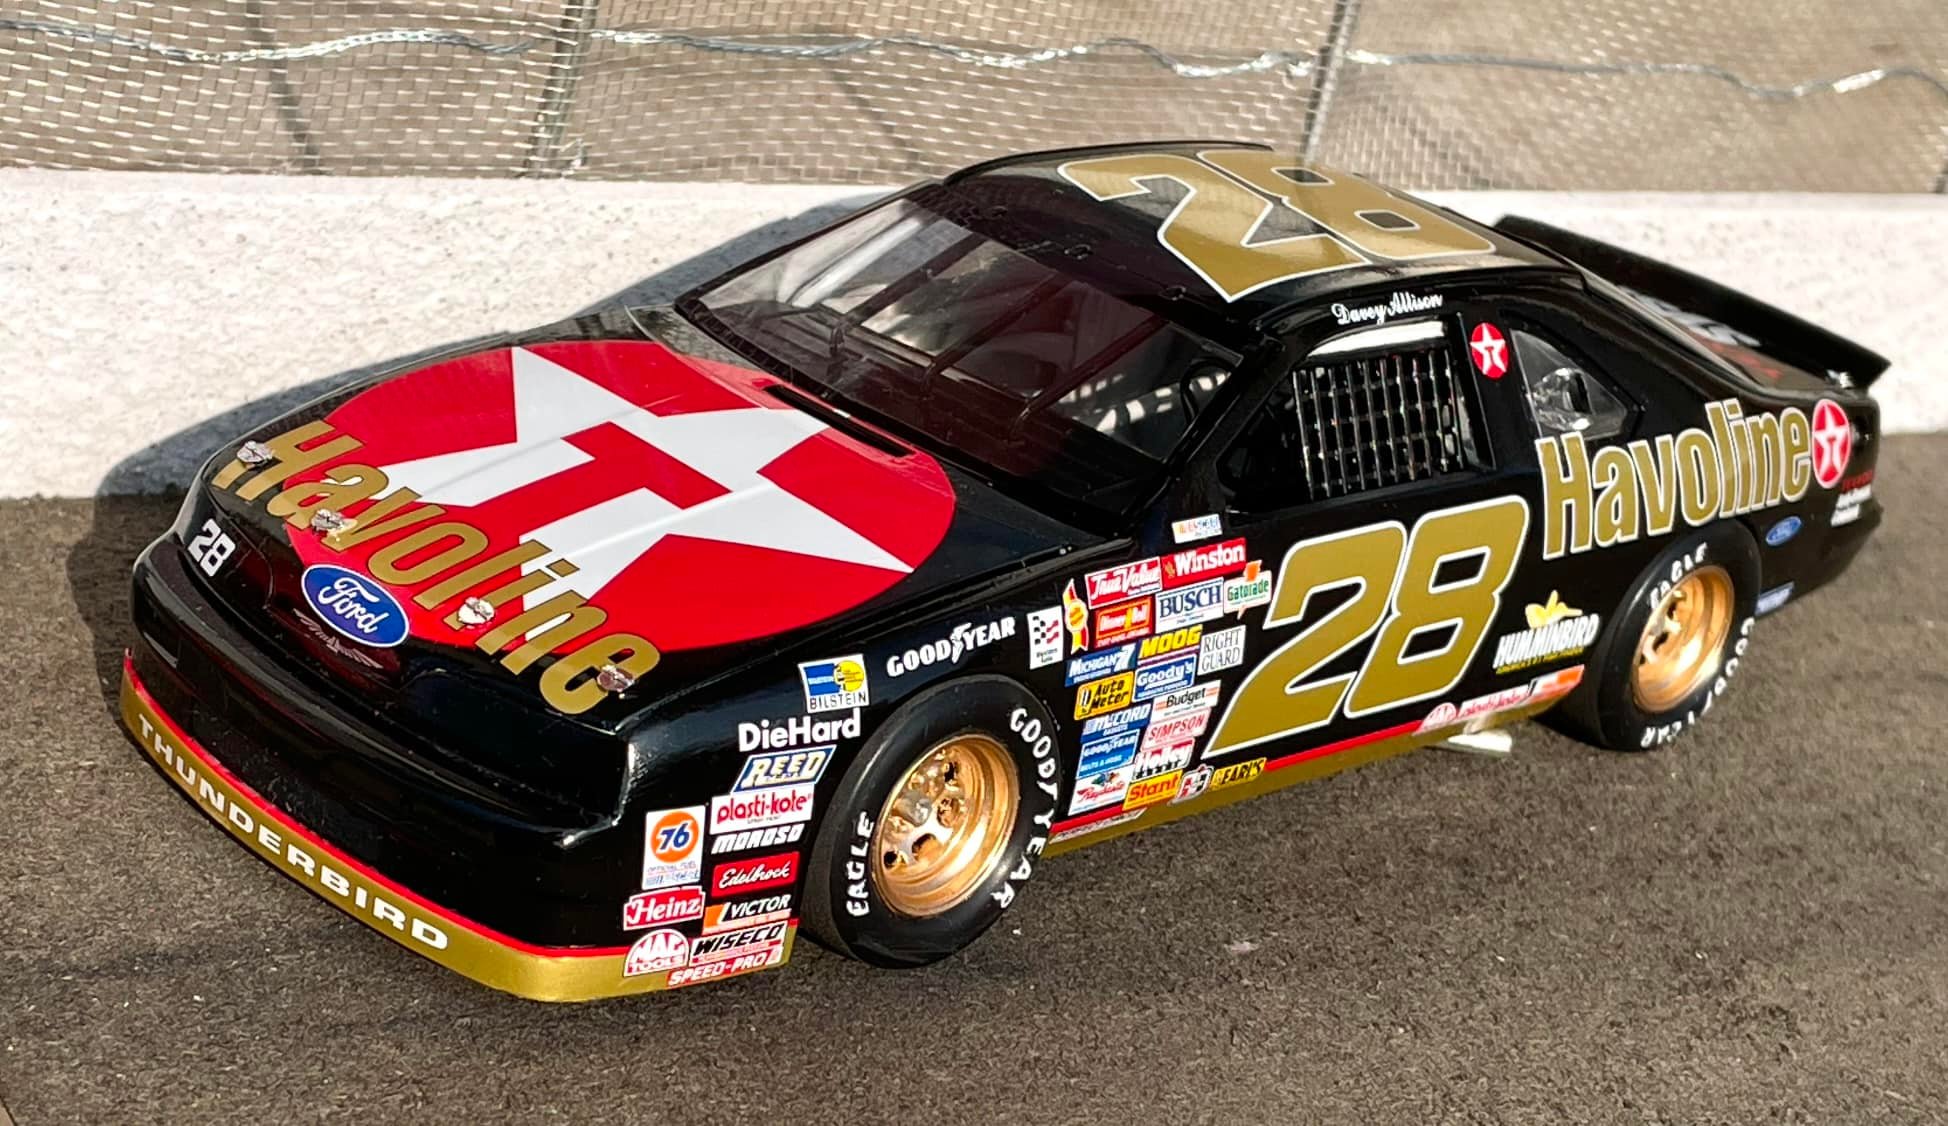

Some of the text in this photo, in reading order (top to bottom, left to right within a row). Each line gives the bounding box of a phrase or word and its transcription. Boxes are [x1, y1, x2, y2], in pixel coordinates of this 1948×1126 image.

[1058, 149, 1497, 303] 28
[1331, 291, 1443, 325] Davey Allison
[1535, 398, 1812, 560] Havoline
[187, 519, 236, 577] 28
[1174, 543, 1245, 577] Winston
[211, 420, 660, 714] Havoline
[1648, 542, 1708, 611] EAGLE
[317, 576, 389, 634] Ford
[1159, 584, 1221, 619] BUSCH
[1227, 579, 1269, 601] Gatorade
[1138, 623, 1203, 660] MOOG
[1201, 495, 1530, 760] 28
[1203, 628, 1242, 654] RIGHT
[1492, 613, 1599, 670] HUMMINBIRD
[886, 617, 1016, 677] GOODYEAR
[1201, 646, 1241, 672] GUARD
[1095, 679, 1125, 696] Auto
[1136, 660, 1193, 687] Goody's
[809, 690, 867, 711] BILSTEIN
[1091, 691, 1129, 709] Meter
[1166, 687, 1206, 709] Budget
[738, 707, 861, 752] DieHard
[1148, 713, 1206, 741] SIMPSON
[740, 751, 826, 789] REED
[1127, 774, 1179, 801] Stant
[716, 789, 807, 824] plasti-kote
[991, 708, 1059, 909] GOODYEAR
[138, 714, 449, 950] THUNDERBIRD
[657, 821, 692, 852] 76
[718, 861, 791, 889] Edelbrock
[846, 811, 876, 917] EAGLE
[626, 895, 701, 924] Heinz
[730, 894, 792, 919] VICTOR
[631, 933, 685, 961] MAC
[693, 922, 786, 957] WISECO
[626, 954, 685, 976] TOOLS
[668, 952, 764, 986] SPEED-PRO
